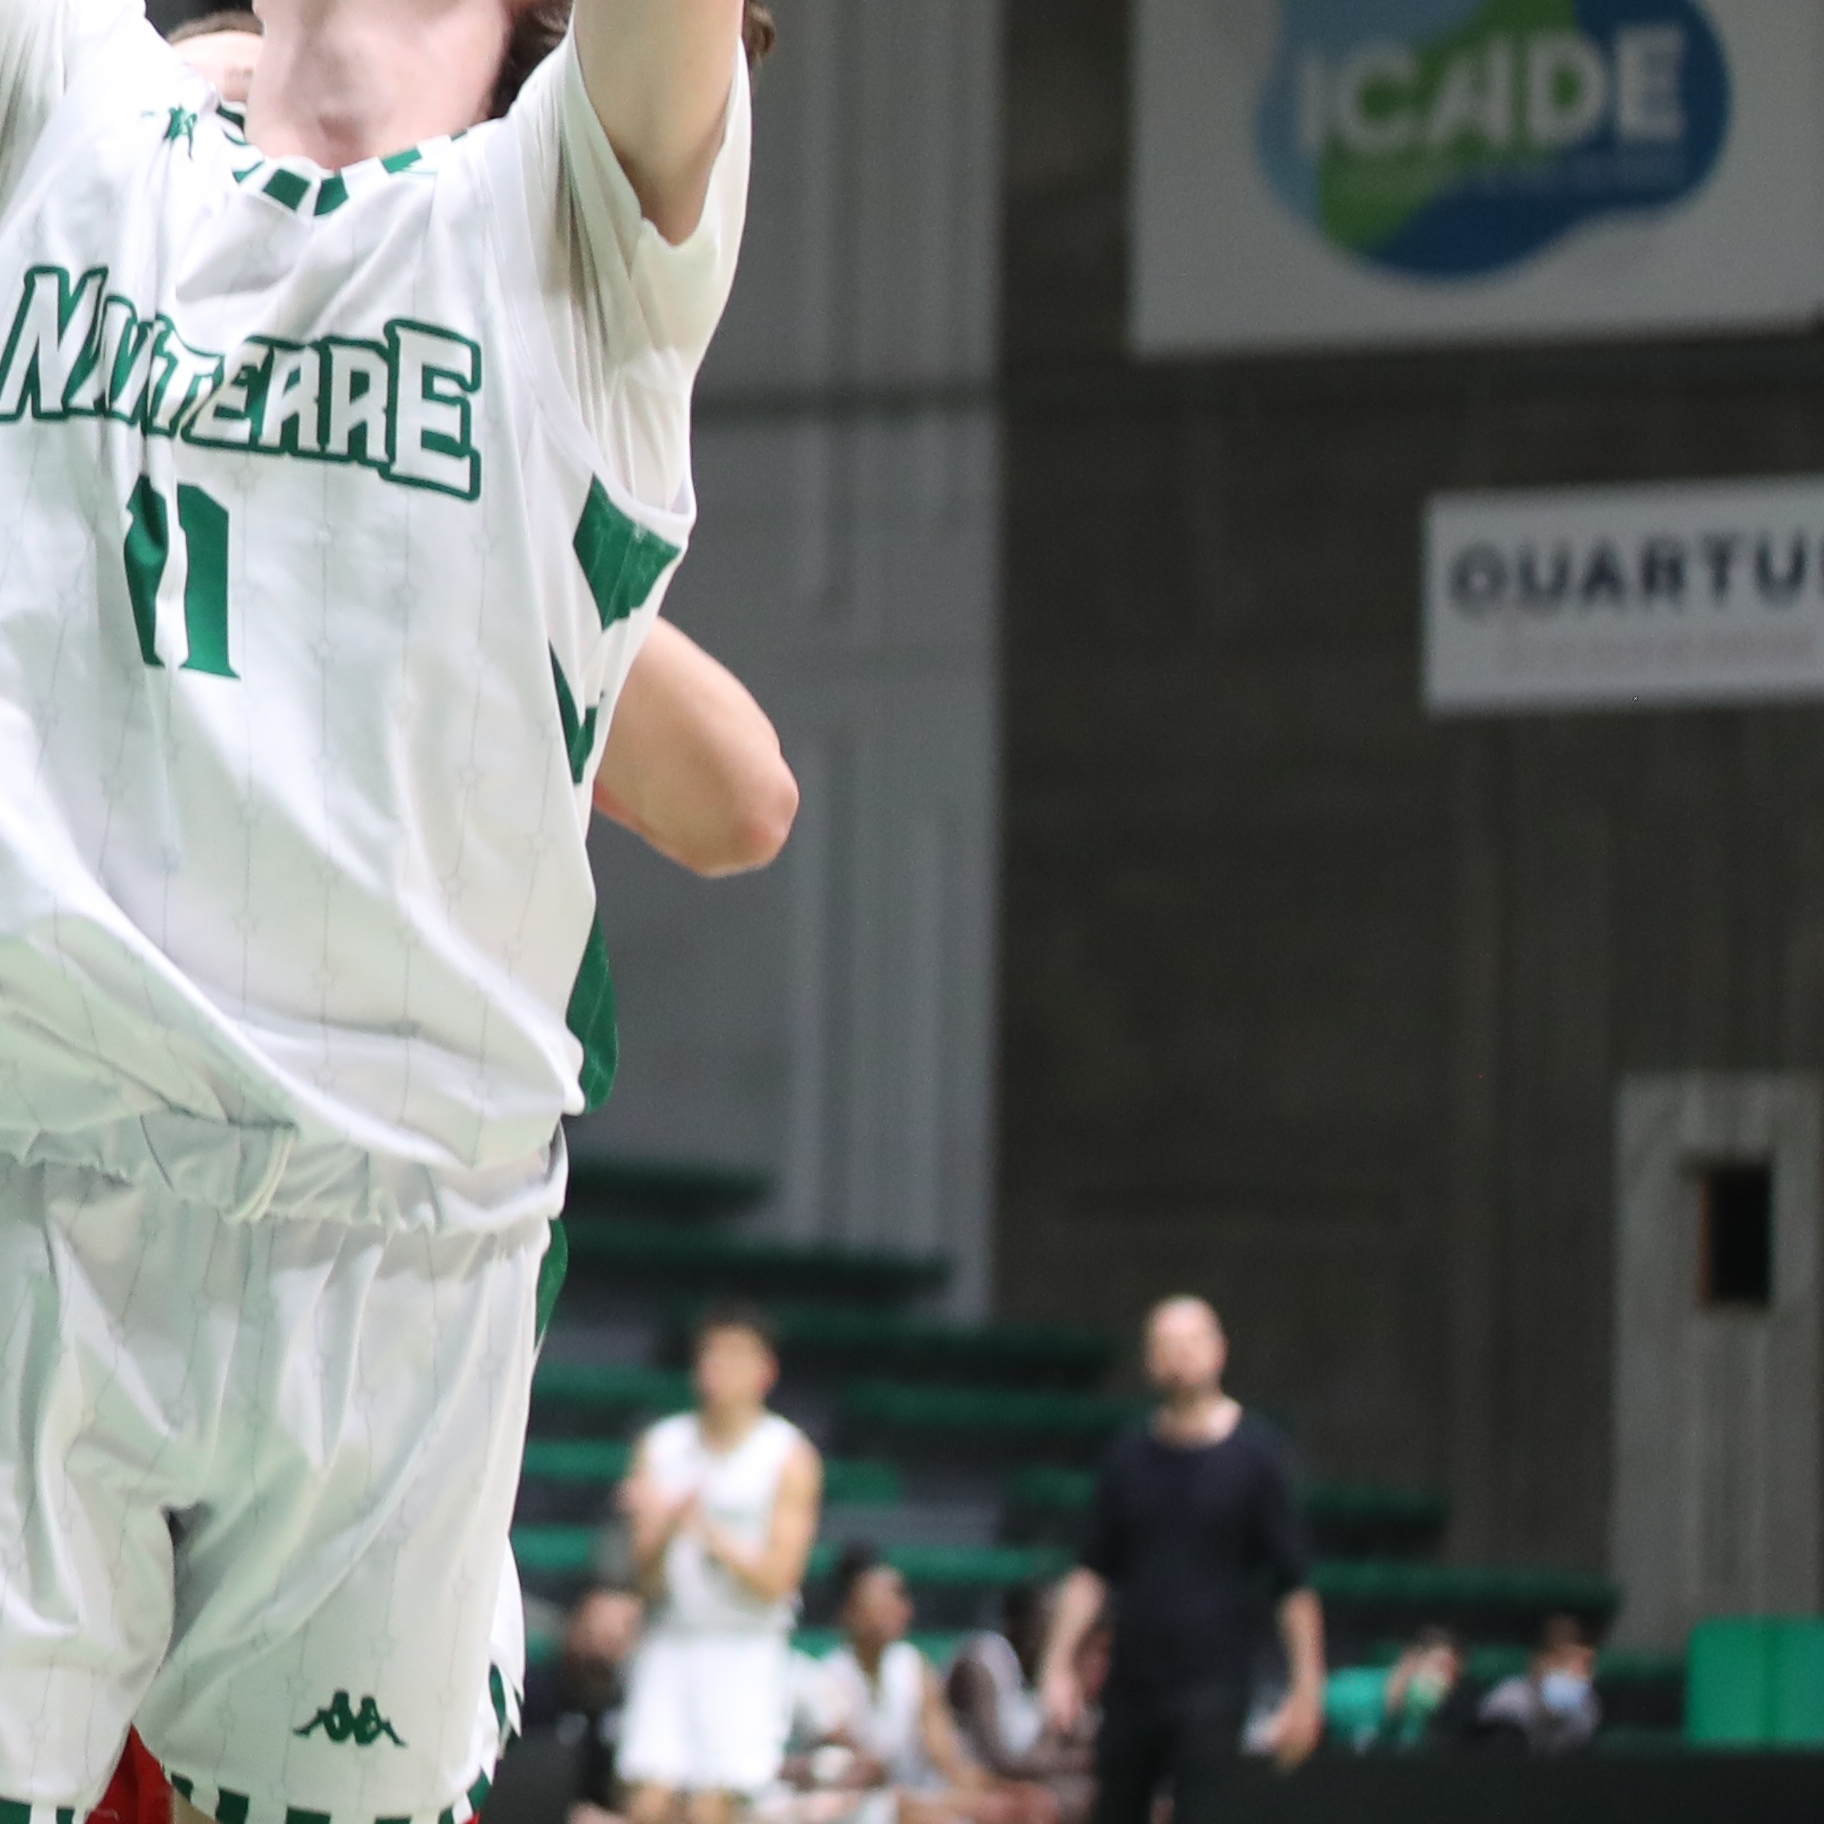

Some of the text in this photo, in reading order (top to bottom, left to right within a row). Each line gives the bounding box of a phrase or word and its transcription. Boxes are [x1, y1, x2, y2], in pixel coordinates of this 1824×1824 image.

[1299, 24, 1686, 154] ICADE
[123, 473, 242, 679] 11
[1449, 528, 1824, 624] QUARTU
